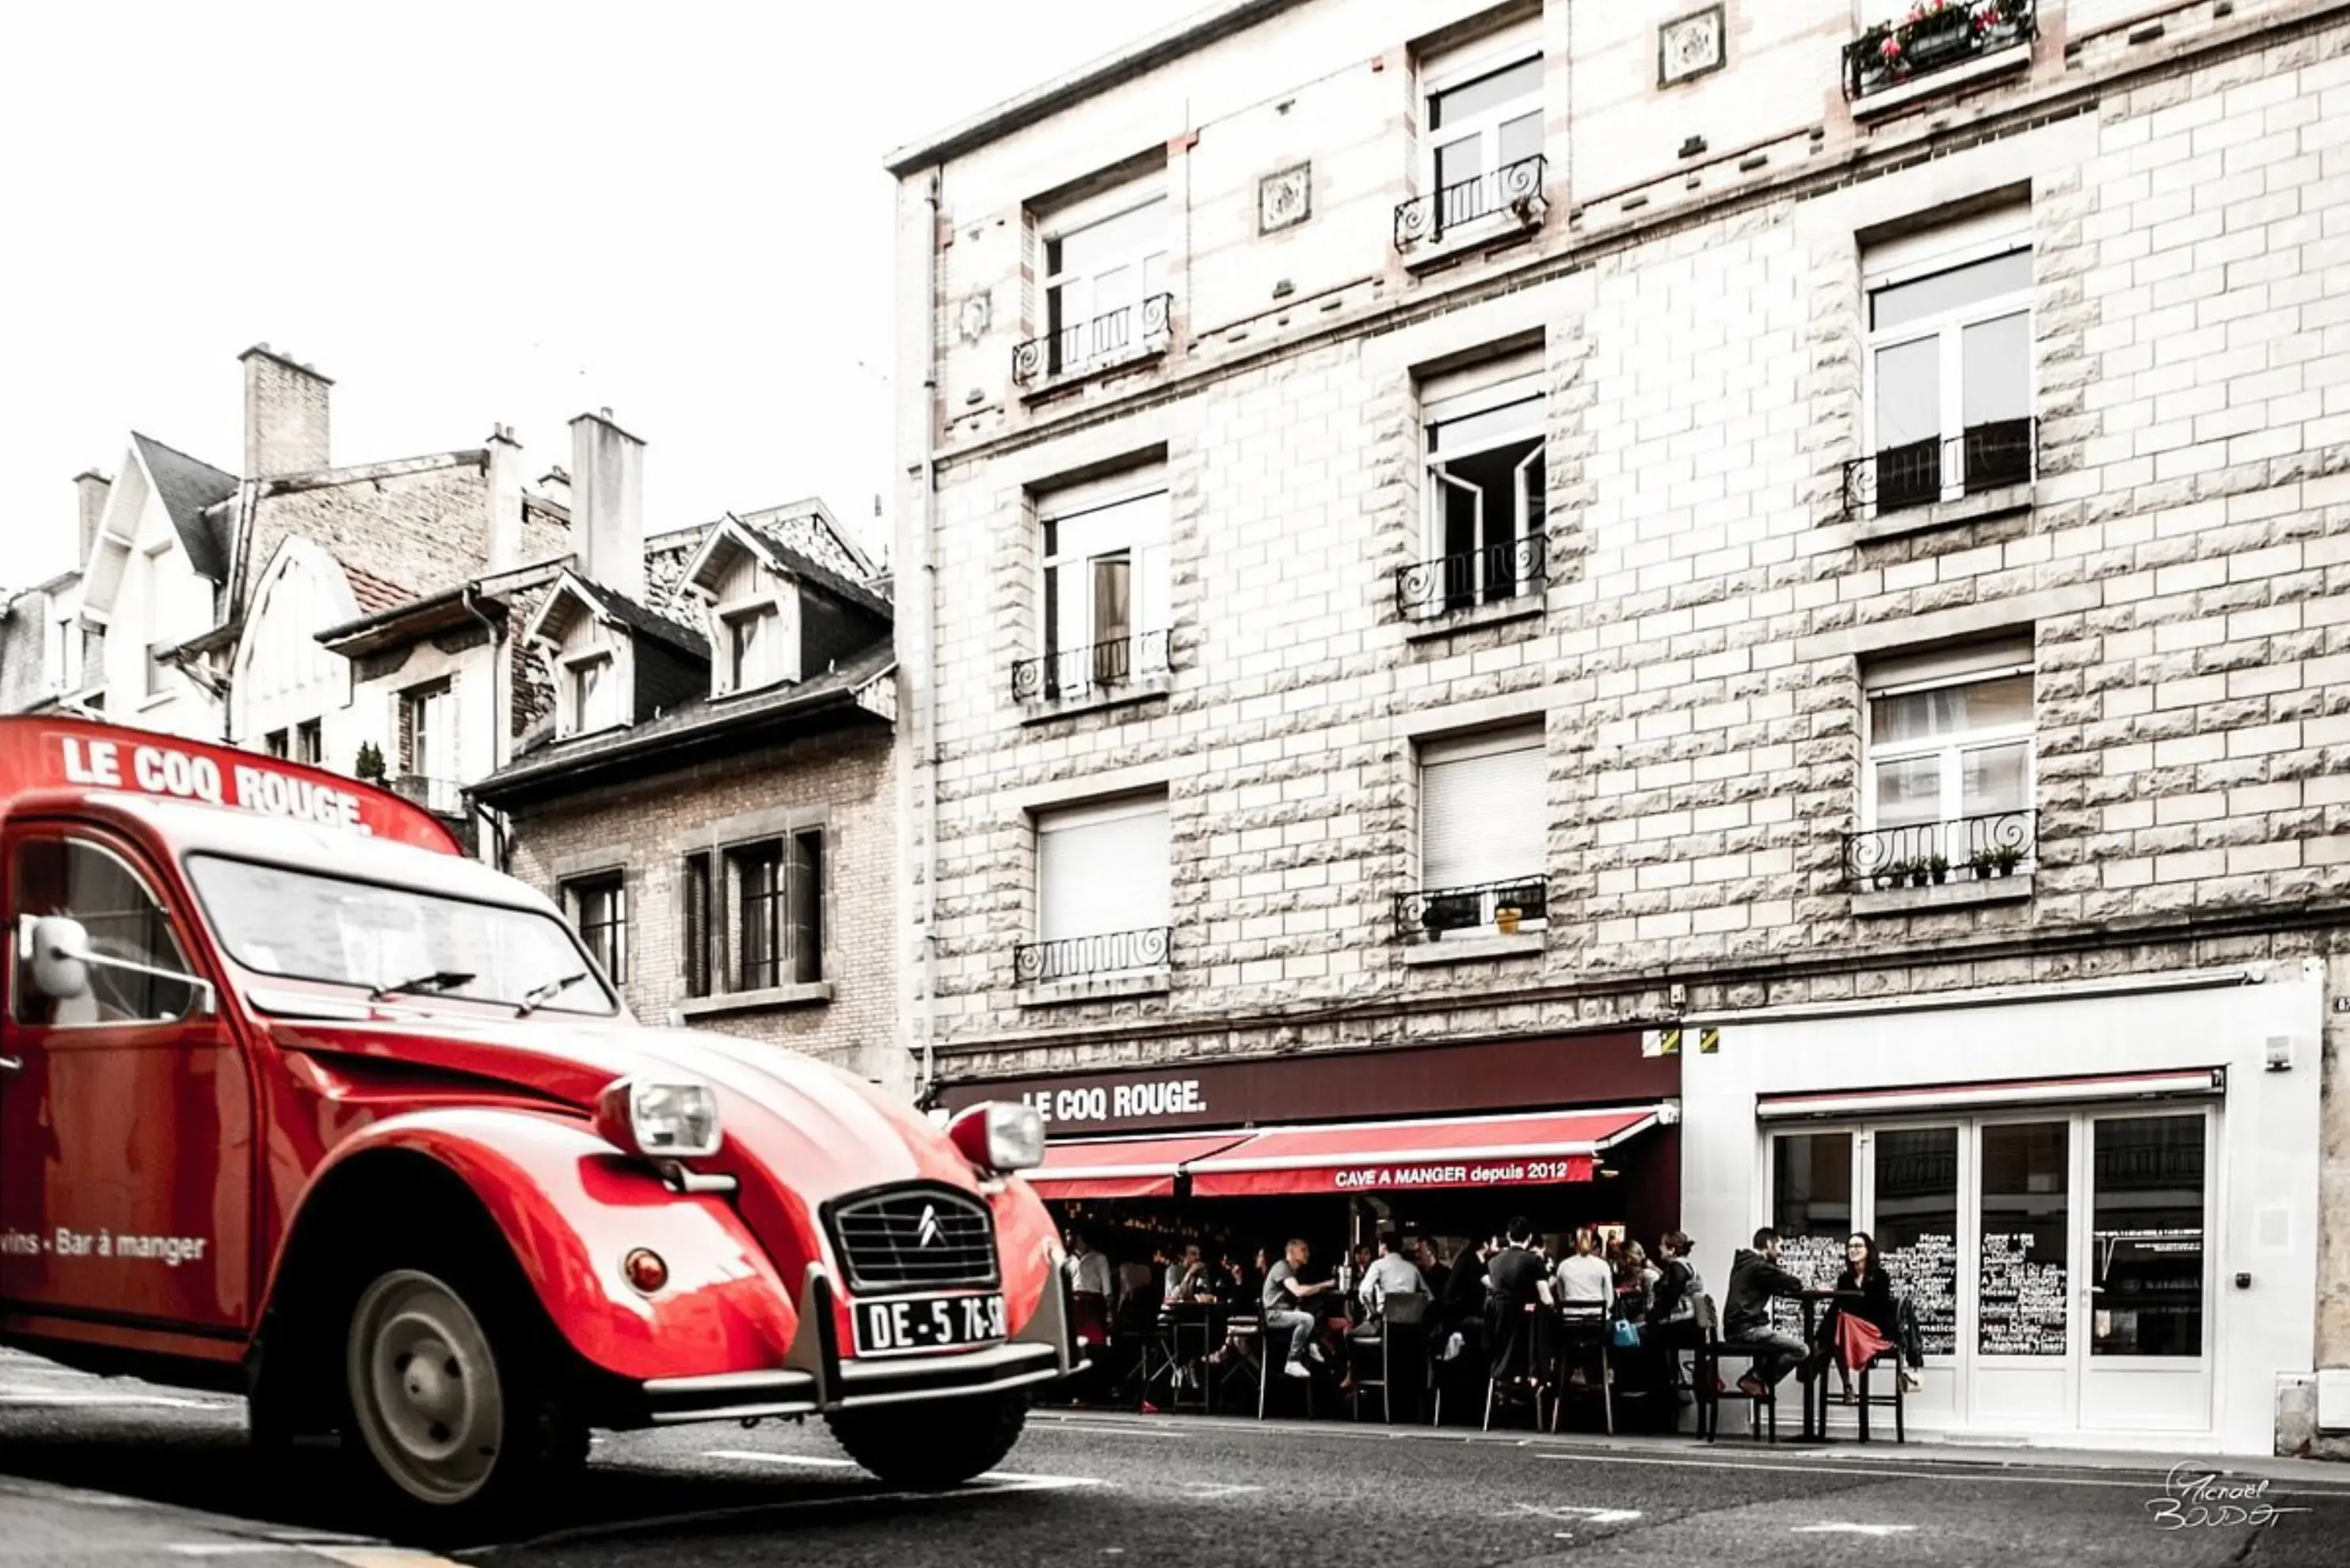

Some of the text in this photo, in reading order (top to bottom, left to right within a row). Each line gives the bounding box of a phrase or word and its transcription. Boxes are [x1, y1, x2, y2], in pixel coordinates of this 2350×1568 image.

[62, 737, 121, 786] LE
[134, 746, 224, 807] COQ
[1057, 1087, 1107, 1121] COQ
[1335, 1162, 1568, 1187] CAVE A MANGER depuis 2012
[55, 1227, 93, 1255] Bar
[97, 1227, 112, 1257] à
[116, 1234, 207, 1267] manger
